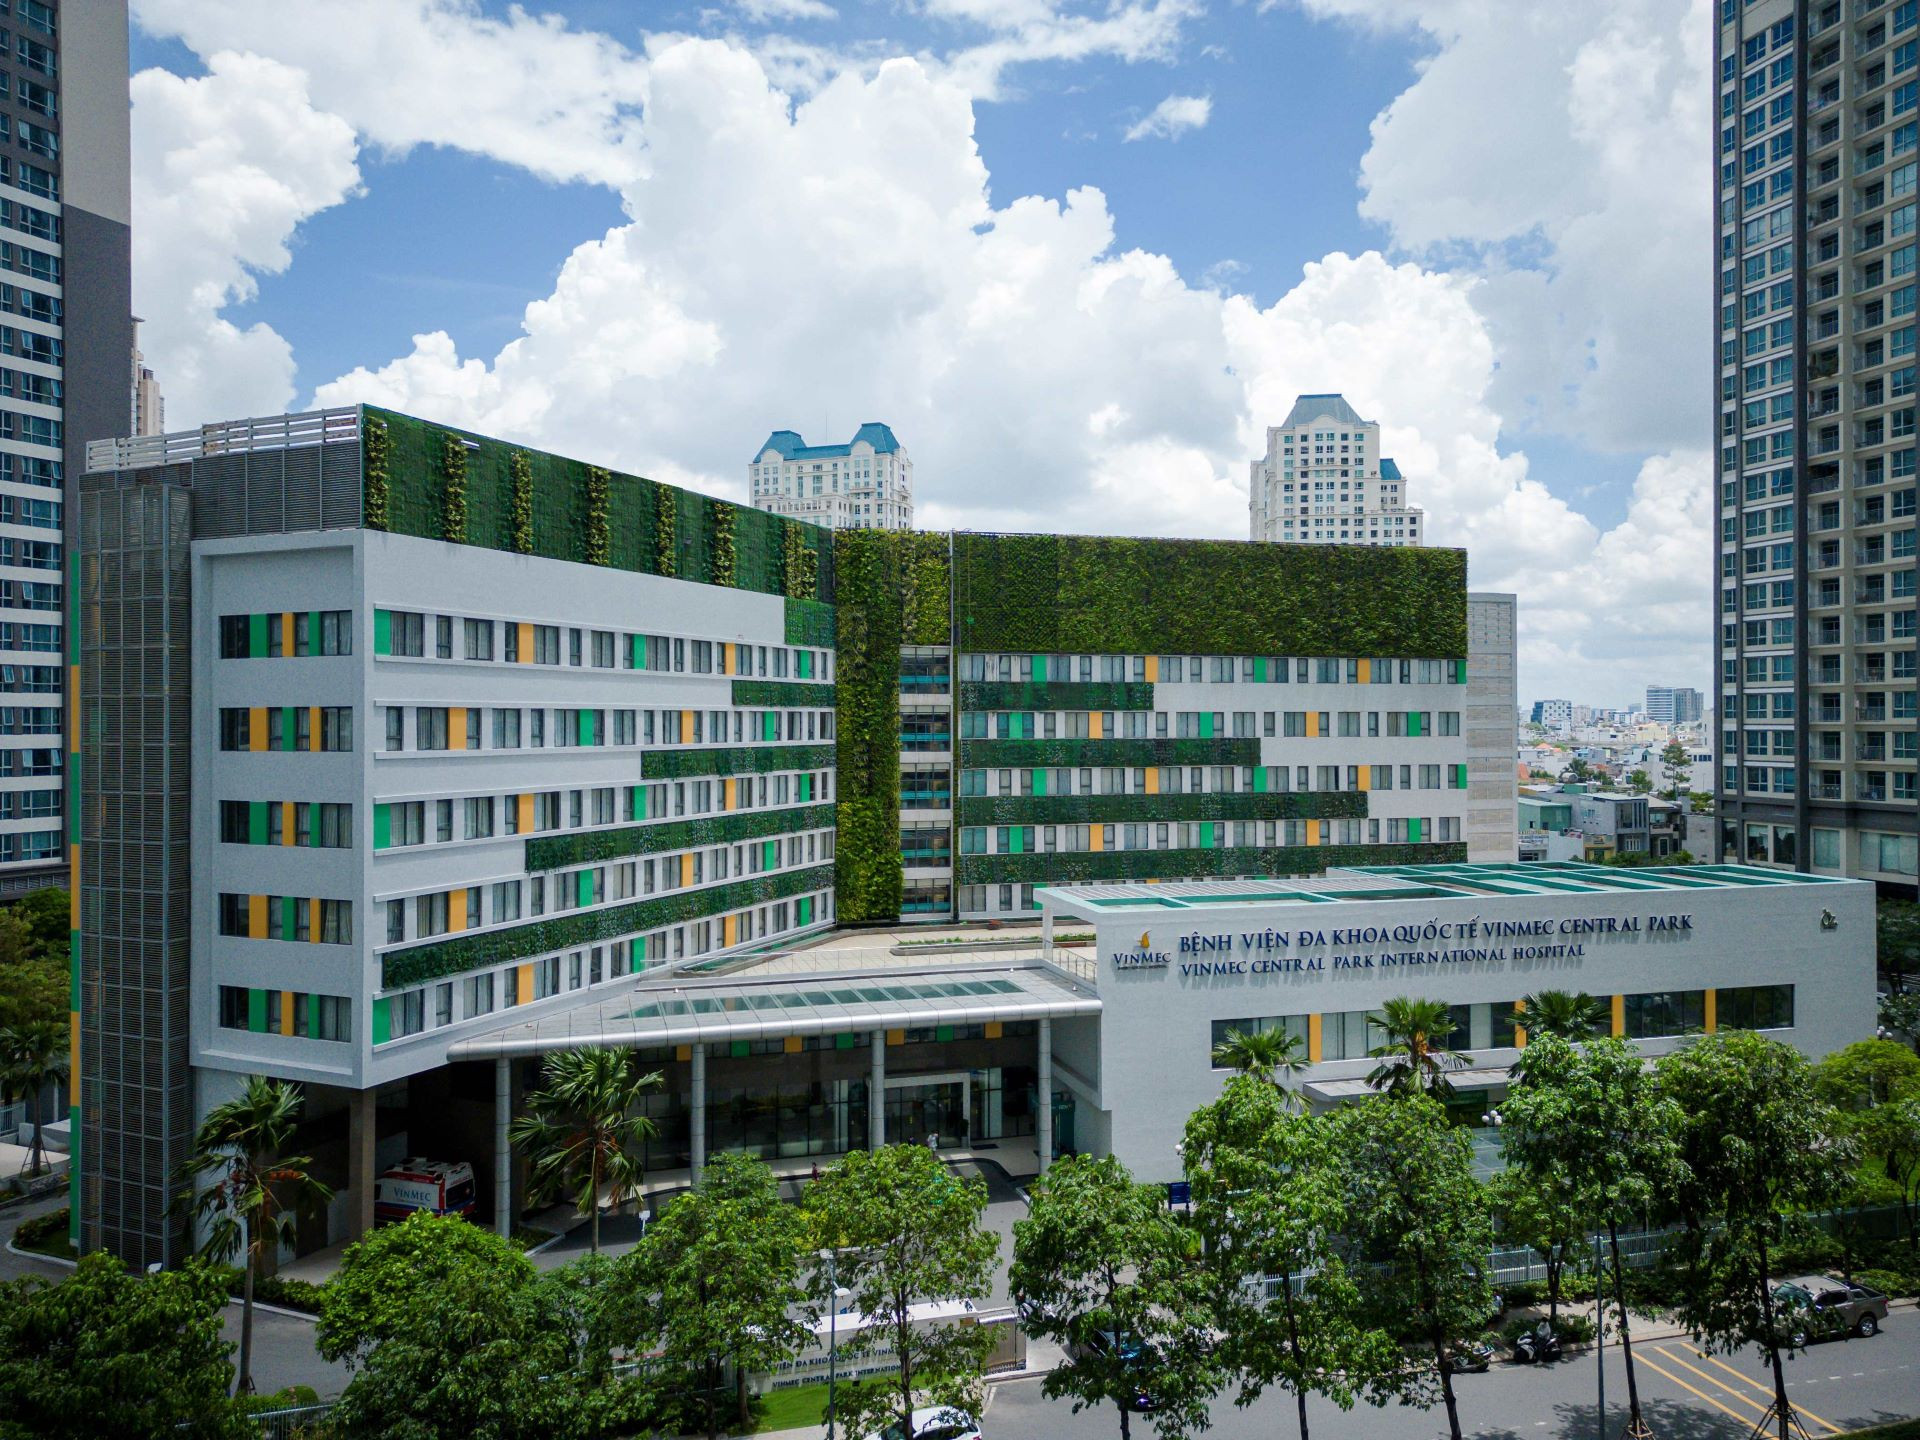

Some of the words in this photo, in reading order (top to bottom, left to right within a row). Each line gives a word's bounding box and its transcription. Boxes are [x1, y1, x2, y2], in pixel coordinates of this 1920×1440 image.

[1180, 931, 1232, 957] BỆNH
[1241, 928, 1289, 952] VIỆN
[1298, 930, 1327, 947] ĐA
[1333, 927, 1390, 945] KHOA
[1393, 917, 1451, 943] QUỐC
[1456, 915, 1480, 939] TẾ
[1482, 919, 1554, 937] VINMEC
[1559, 916, 1641, 934] CENTRAL
[1649, 914, 1694, 931] PARK
[1181, 961, 1247, 976] VINMEC
[1251, 958, 1325, 974] CENTRAL
[1334, 955, 1375, 969] PARK
[1381, 948, 1507, 967] INTERNATIONAL
[1513, 944, 1585, 960] HOSPITAL
